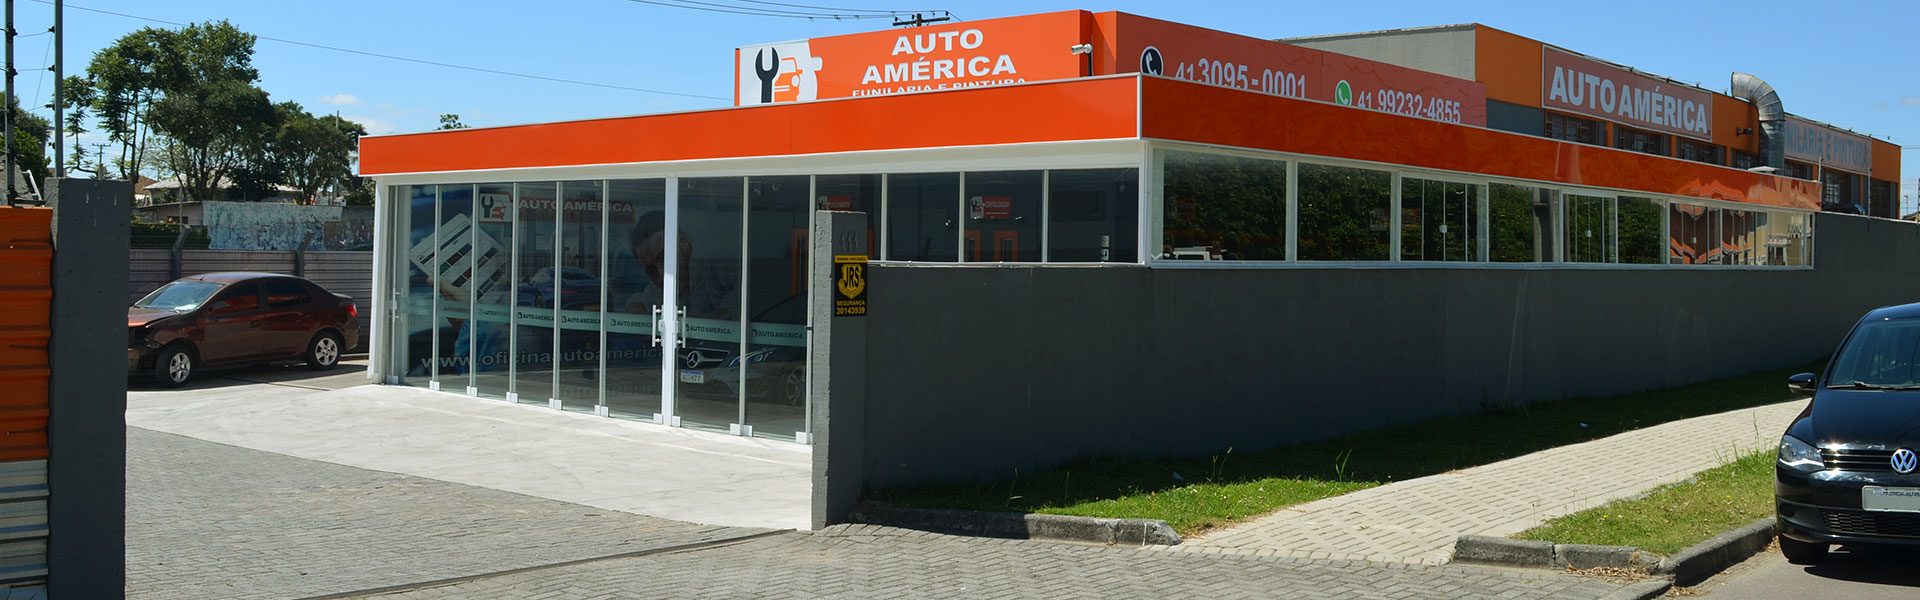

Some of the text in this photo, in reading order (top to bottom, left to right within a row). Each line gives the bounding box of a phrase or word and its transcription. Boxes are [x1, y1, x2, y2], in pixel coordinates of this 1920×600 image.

[891, 28, 984, 56] AUTO
[861, 54, 1017, 85] AMÉRICA
[1357, 90, 1372, 109] 41
[844, 266, 860, 288] JRS
